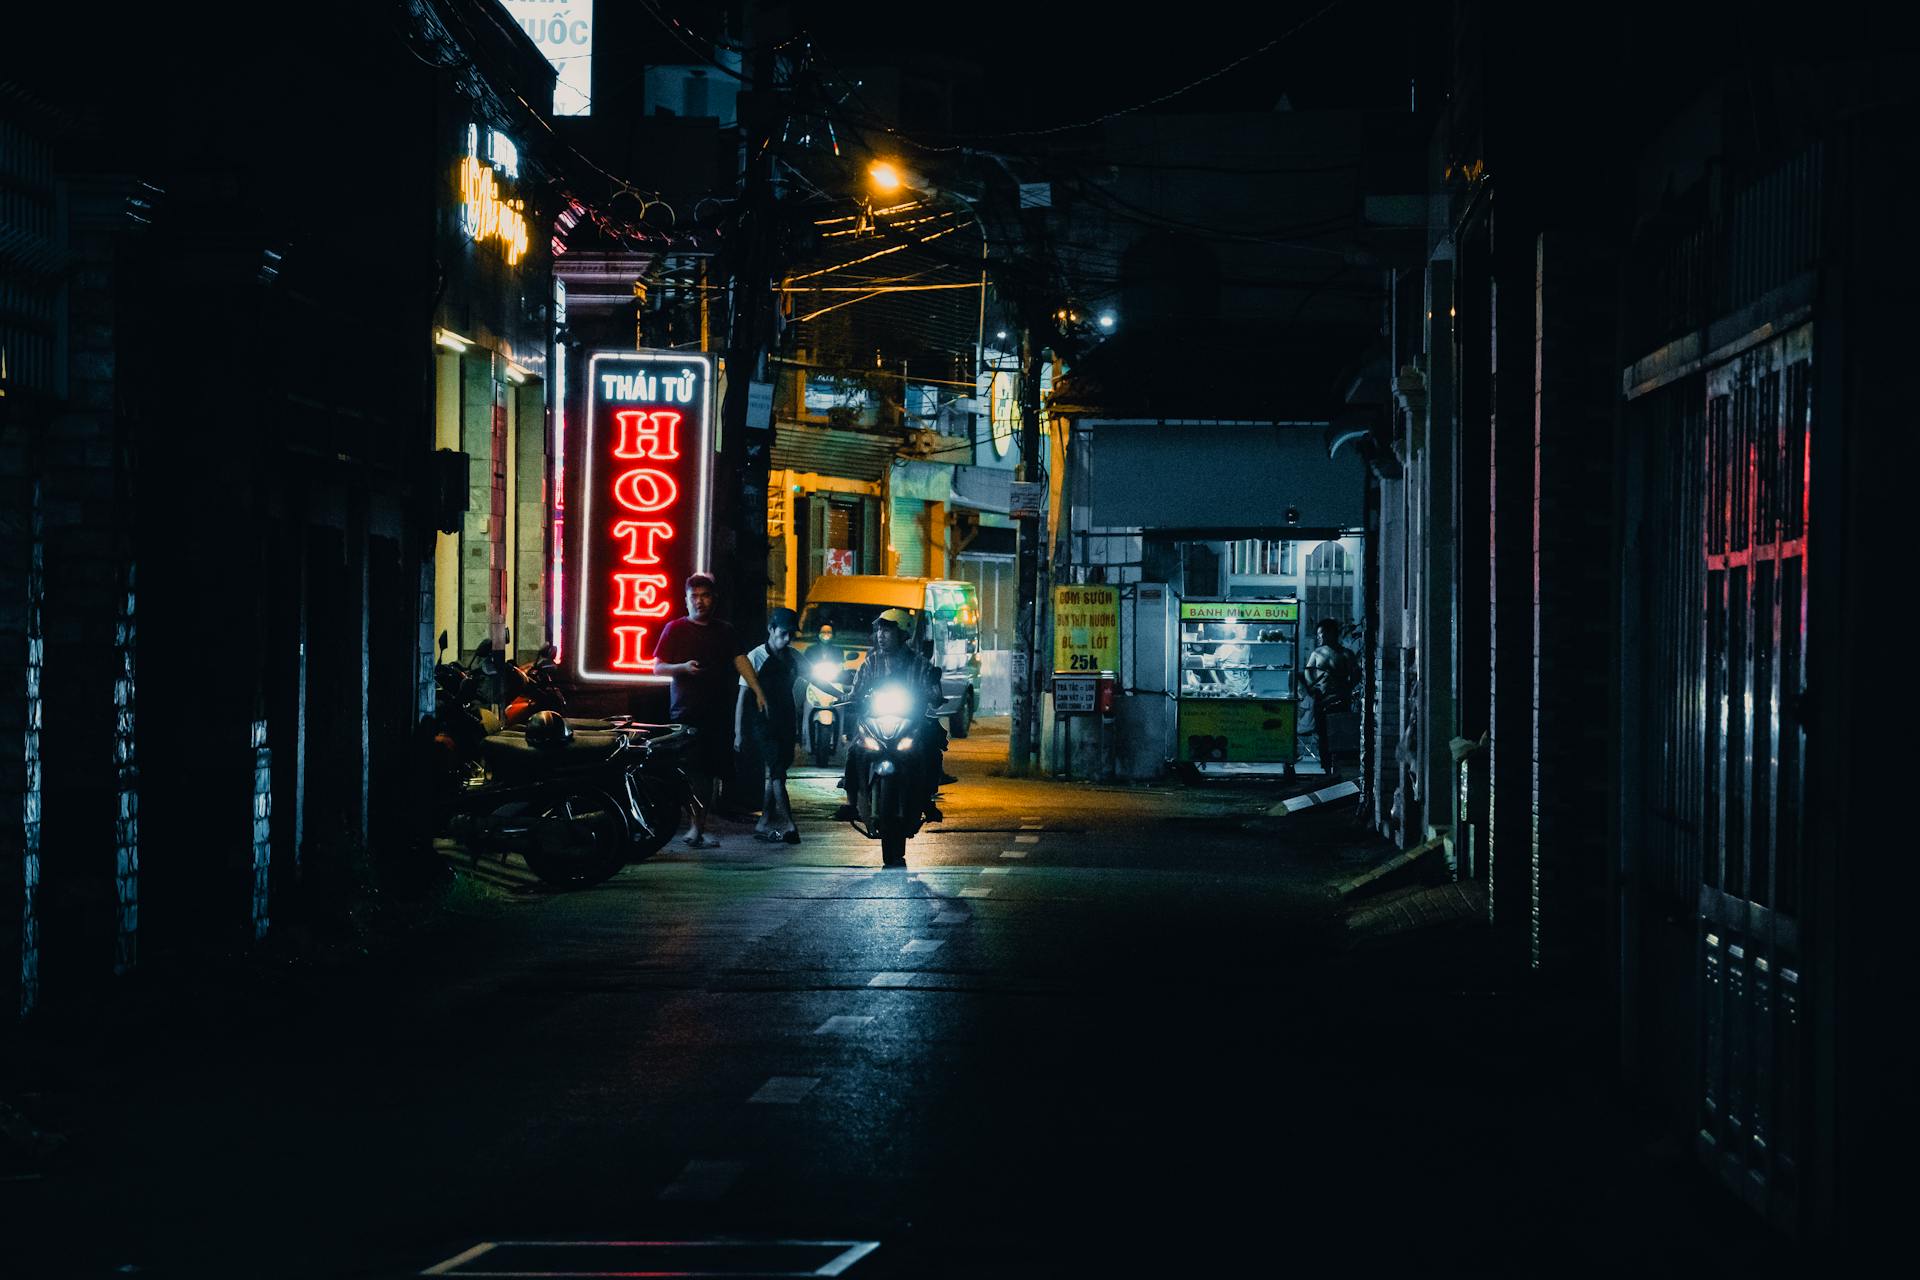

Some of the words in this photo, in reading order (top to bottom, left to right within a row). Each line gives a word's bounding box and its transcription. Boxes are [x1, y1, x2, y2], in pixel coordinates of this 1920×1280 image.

[517, 10, 589, 45] UỐC
[602, 369, 656, 401] THÁI
[662, 368, 696, 403] TỬ
[613, 411, 682, 669] HOTEL
[1265, 606, 1289, 617] BÚN
